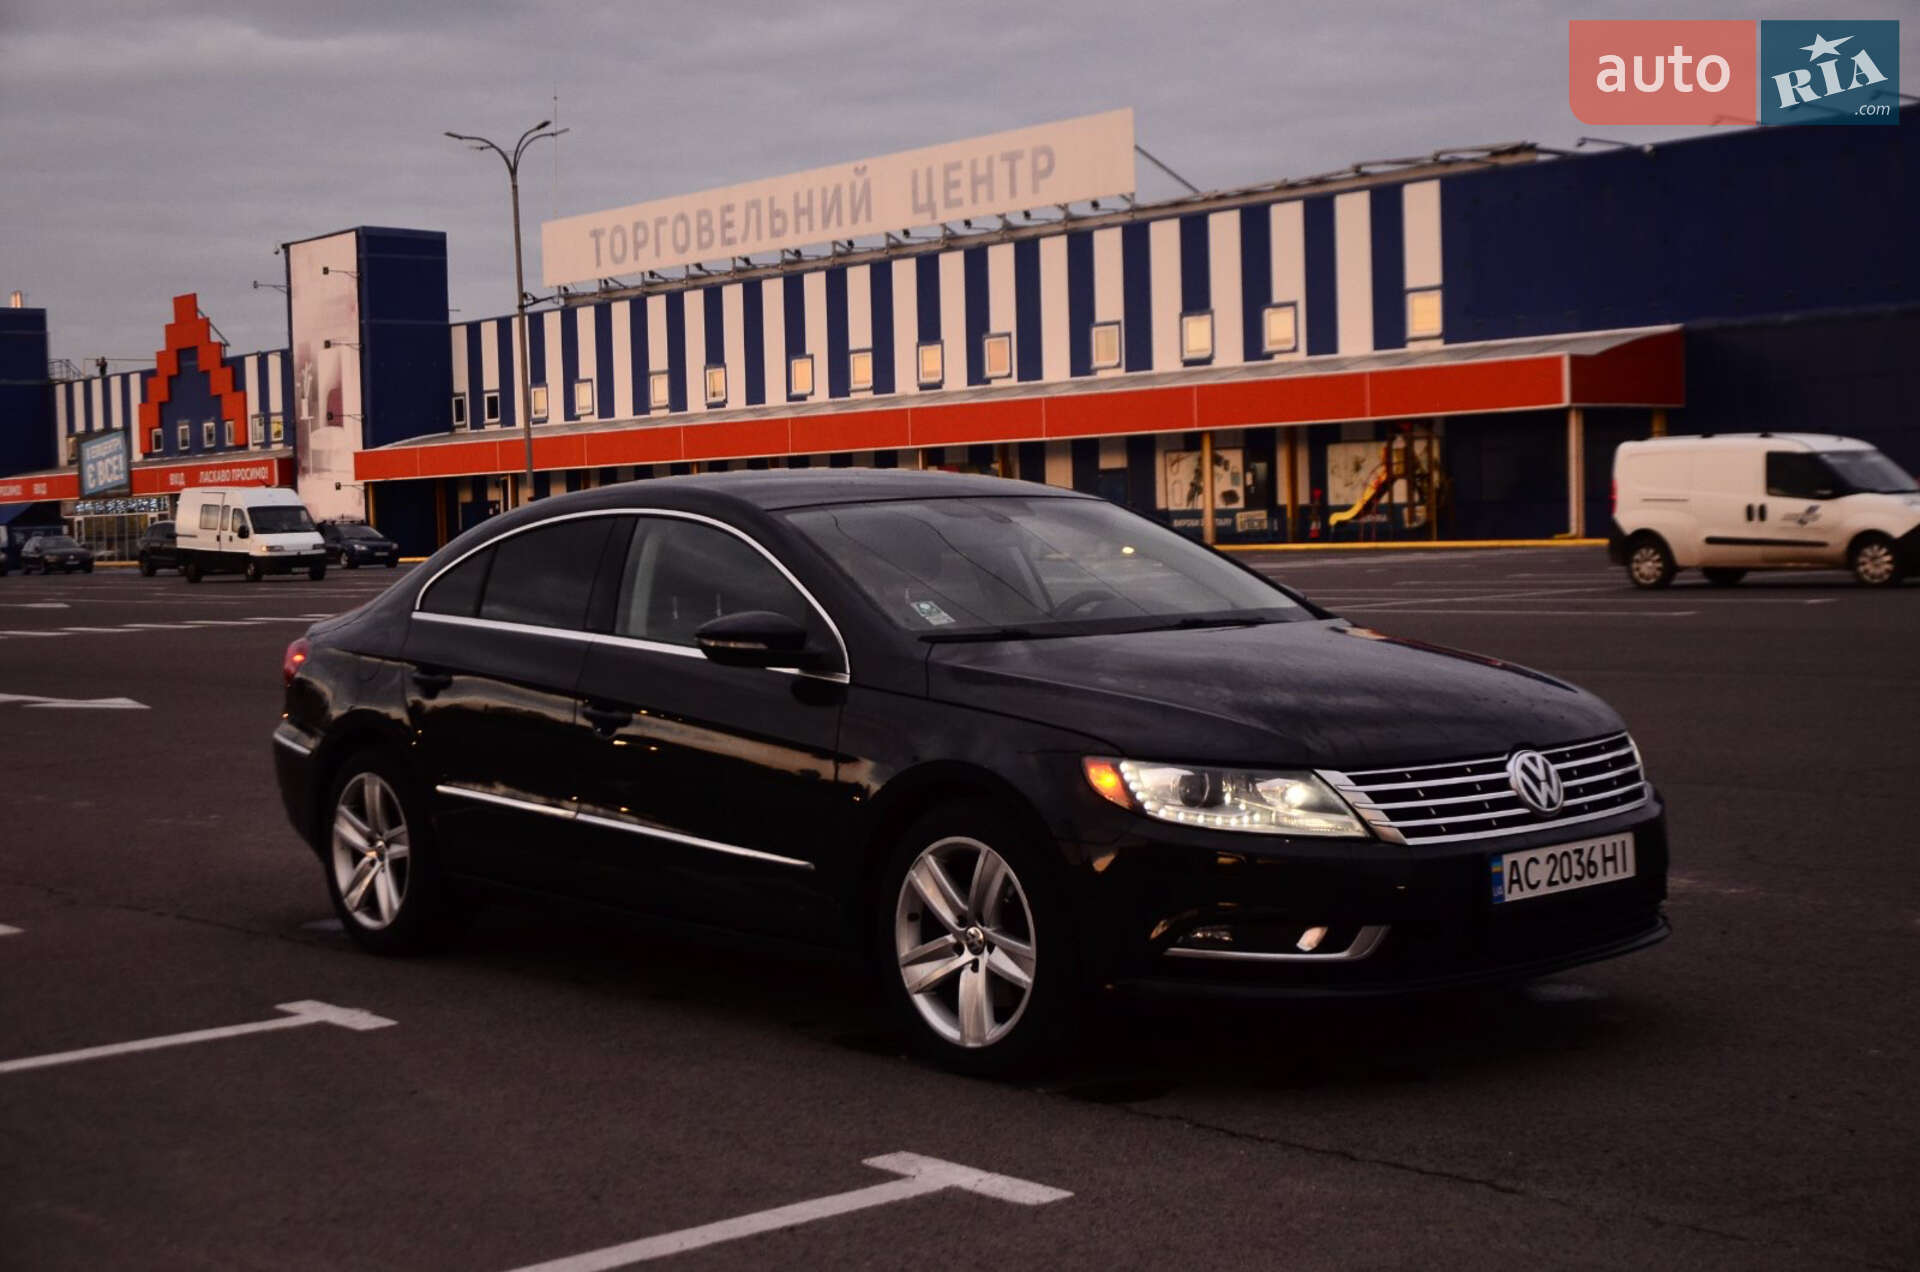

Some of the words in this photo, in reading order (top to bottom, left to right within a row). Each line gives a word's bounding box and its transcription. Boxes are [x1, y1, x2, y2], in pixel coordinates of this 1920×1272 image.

[588, 165, 873, 268] ТОРГОВЕЛЬНИЙ
[911, 144, 1056, 221] ЦЕНТР
[199, 469, 231, 483] ЛАСКАВО
[1507, 856, 1541, 895] AC
[1546, 846, 1598, 887] 2036
[1602, 839, 1627, 877] HI
